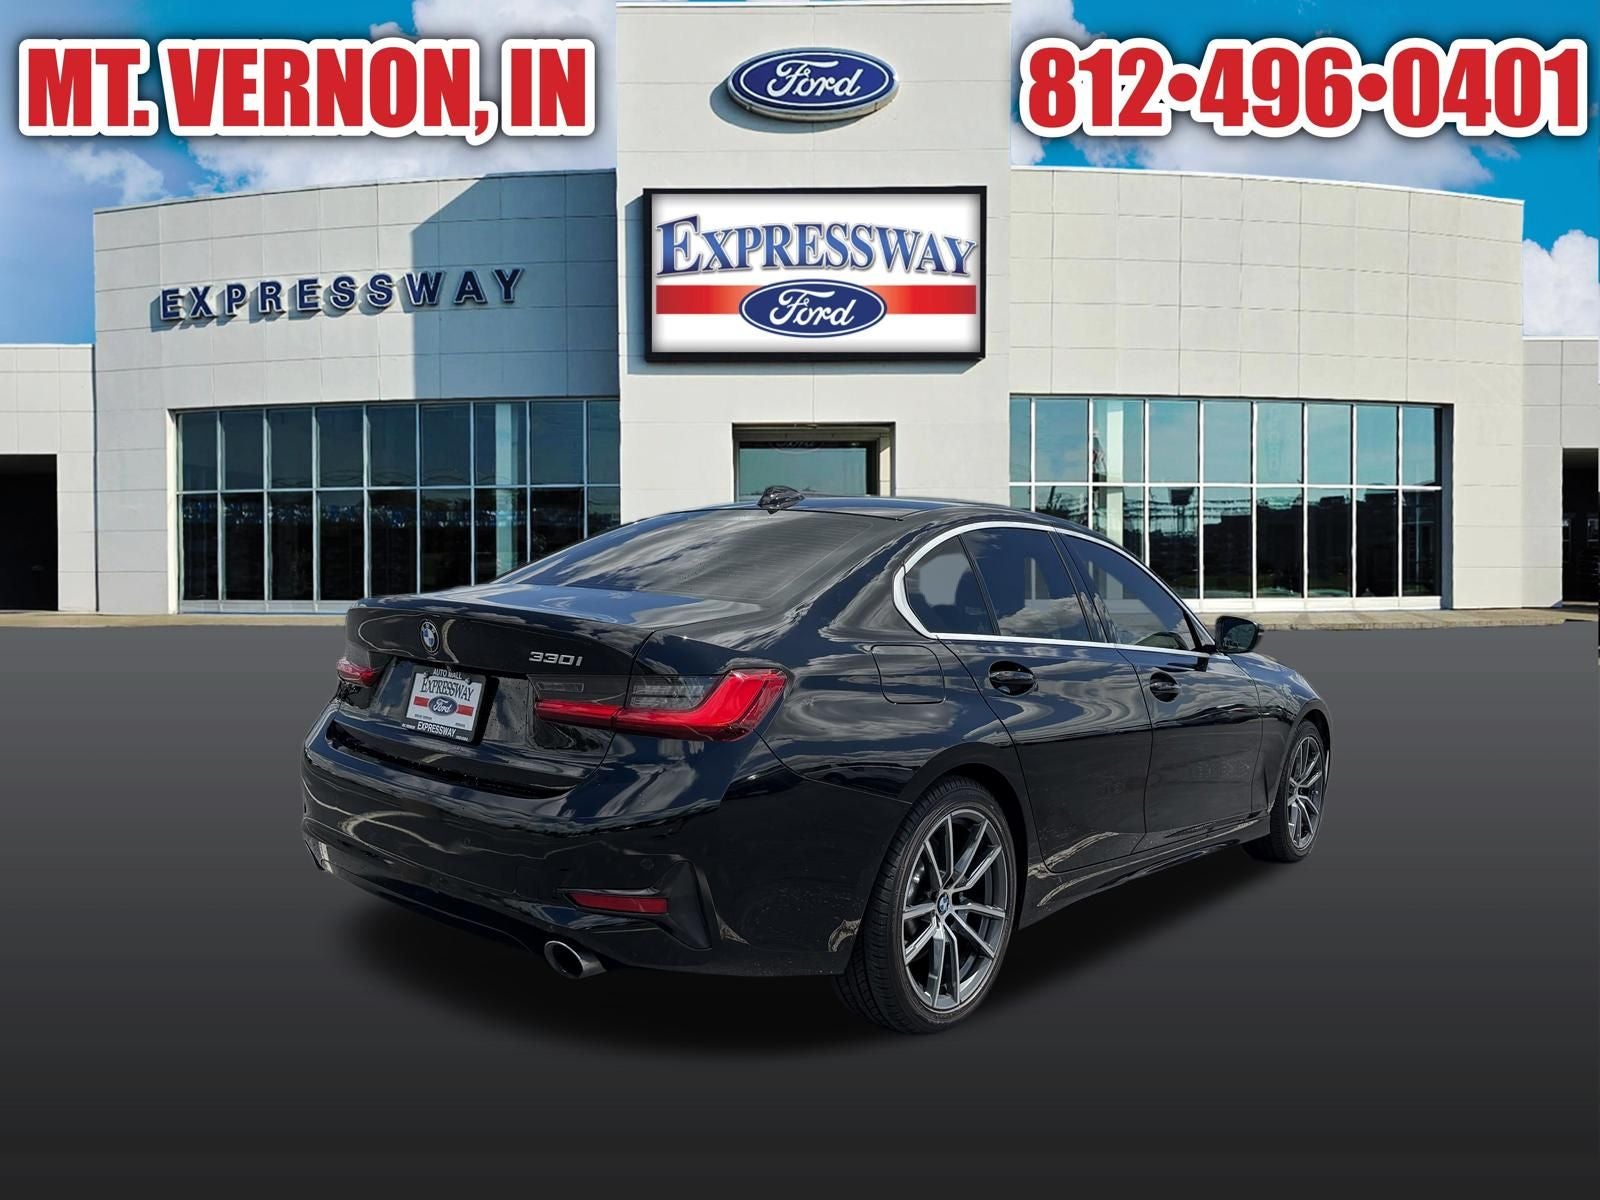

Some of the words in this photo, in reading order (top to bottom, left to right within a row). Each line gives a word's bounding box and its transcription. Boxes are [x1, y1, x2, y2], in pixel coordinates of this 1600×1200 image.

[767, 59, 864, 97] Ford
[655, 213, 978, 278] EXPRESSWAY
[160, 267, 523, 321] EXPRESSWAY
[769, 288, 857, 327] Ford
[432, 668, 448, 678] AUTO
[448, 672, 462, 680] MALL
[420, 679, 474, 702] EXPRESSWAY
[432, 698, 453, 714] Ford
[417, 721, 457, 738] EXPRESSWAY
